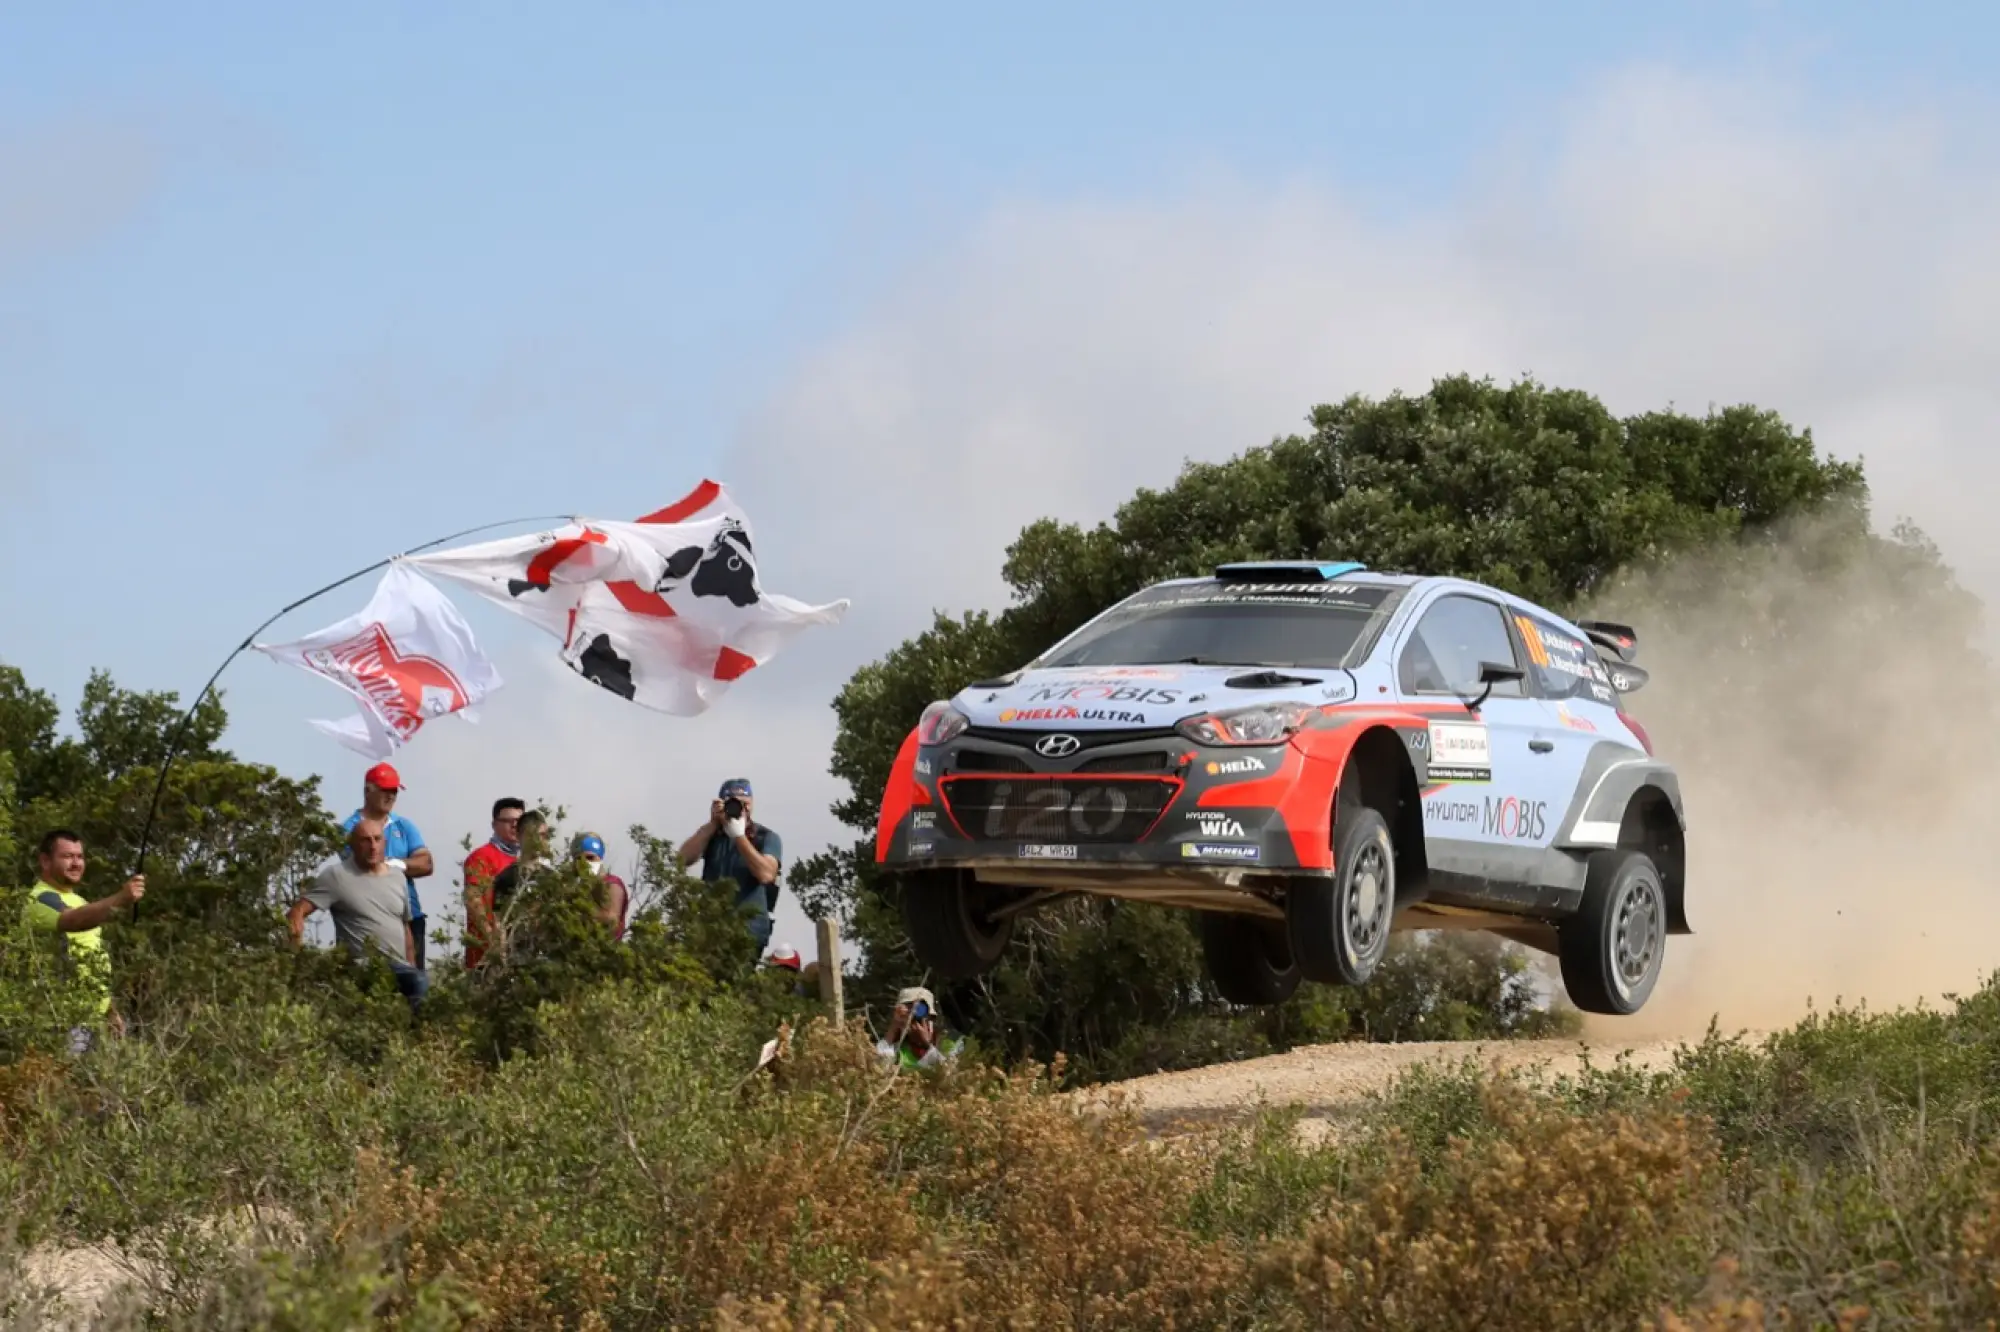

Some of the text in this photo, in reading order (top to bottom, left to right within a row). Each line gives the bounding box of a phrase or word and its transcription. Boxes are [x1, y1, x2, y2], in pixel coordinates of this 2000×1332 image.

[1224, 583, 1359, 595] HYUNDAI
[1028, 685, 1183, 705] MOBIS
[1017, 704, 1146, 724] HELIX ULTRA
[1220, 756, 1266, 774] HELIX
[984, 783, 1128, 838] i20
[1185, 811, 1226, 821] HYUNDAI
[1426, 796, 1547, 841] HYUNDAI MOBIS
[1201, 846, 1257, 858] MICHELIN
